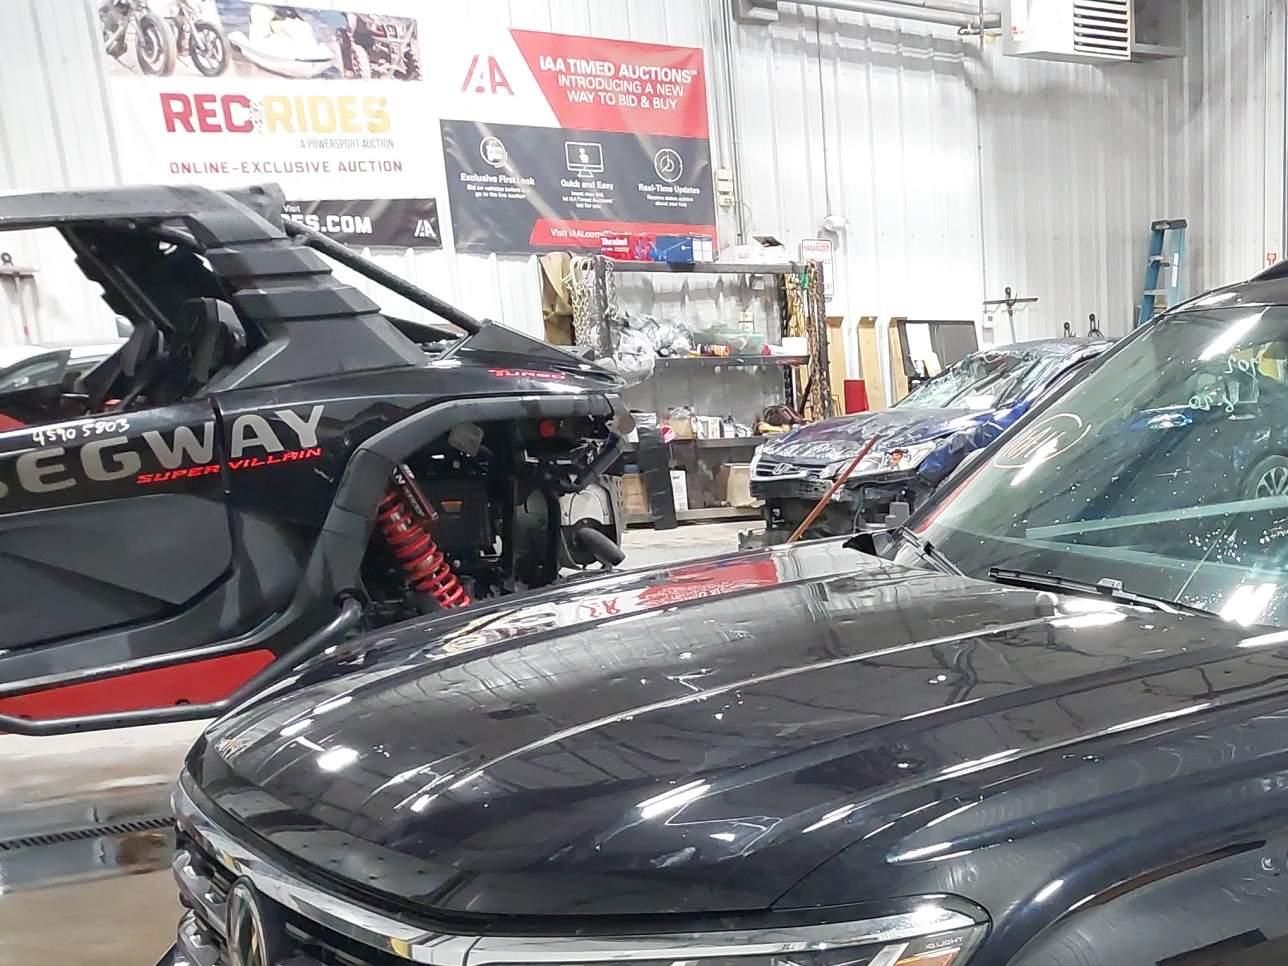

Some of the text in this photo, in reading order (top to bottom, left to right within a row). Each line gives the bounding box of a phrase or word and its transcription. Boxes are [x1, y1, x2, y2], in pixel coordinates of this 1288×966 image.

[539, 56, 566, 72] IAA
[567, 59, 615, 77] TIMED
[558, 74, 684, 97] INTRODUCING A NEW
[567, 90, 678, 110] WAY TO BID & BUY
[262, 95, 392, 134] RIDES
[362, 138, 394, 149] AUCTION
[170, 160, 403, 175] ONLINE-EXCLUSIVE AUCTION
[460, 172, 498, 184] Exclusive
[560, 179, 614, 190] Quick and Easy
[638, 183, 700, 194] Real-Time Updates
[283, 204, 300, 213] Visit
[551, 228, 567, 237] Visit
[0, 405, 325, 499] EGWAY
[136, 447, 323, 485] SUPER VILLAIN
